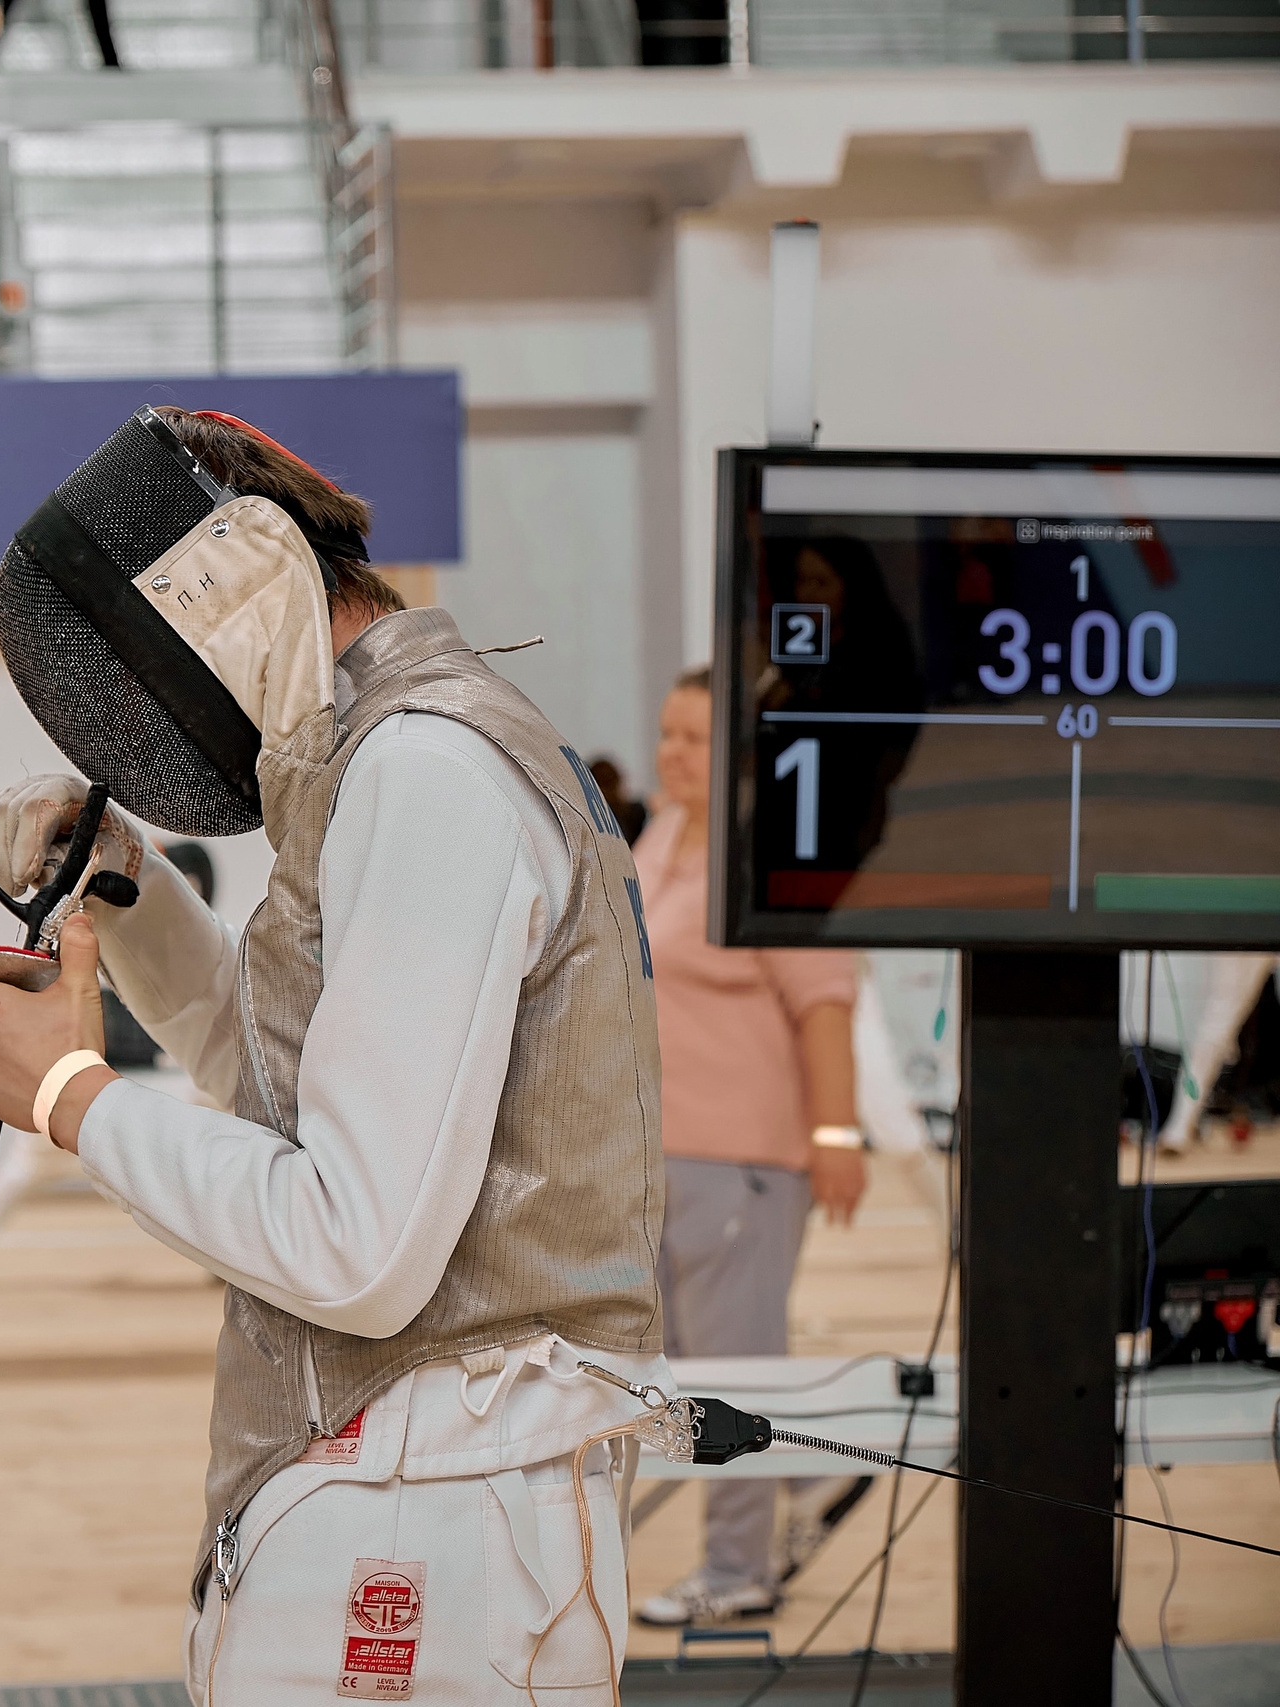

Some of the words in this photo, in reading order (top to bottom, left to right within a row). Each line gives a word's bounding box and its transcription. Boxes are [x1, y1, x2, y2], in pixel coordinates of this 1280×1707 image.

[1069, 555, 1090, 602] 1
[785, 614, 816, 655] 2
[978, 608, 1178, 697] 3:00
[1056, 703, 1099, 739] 60
[775, 737, 820, 860] 1
[348, 1442, 357, 1454] 2
[358, 1640, 412, 1659] allstar
[348, 1662, 367, 1670] Made
[377, 1664, 409, 1674] Germany
[400, 1679, 409, 1691] 2
